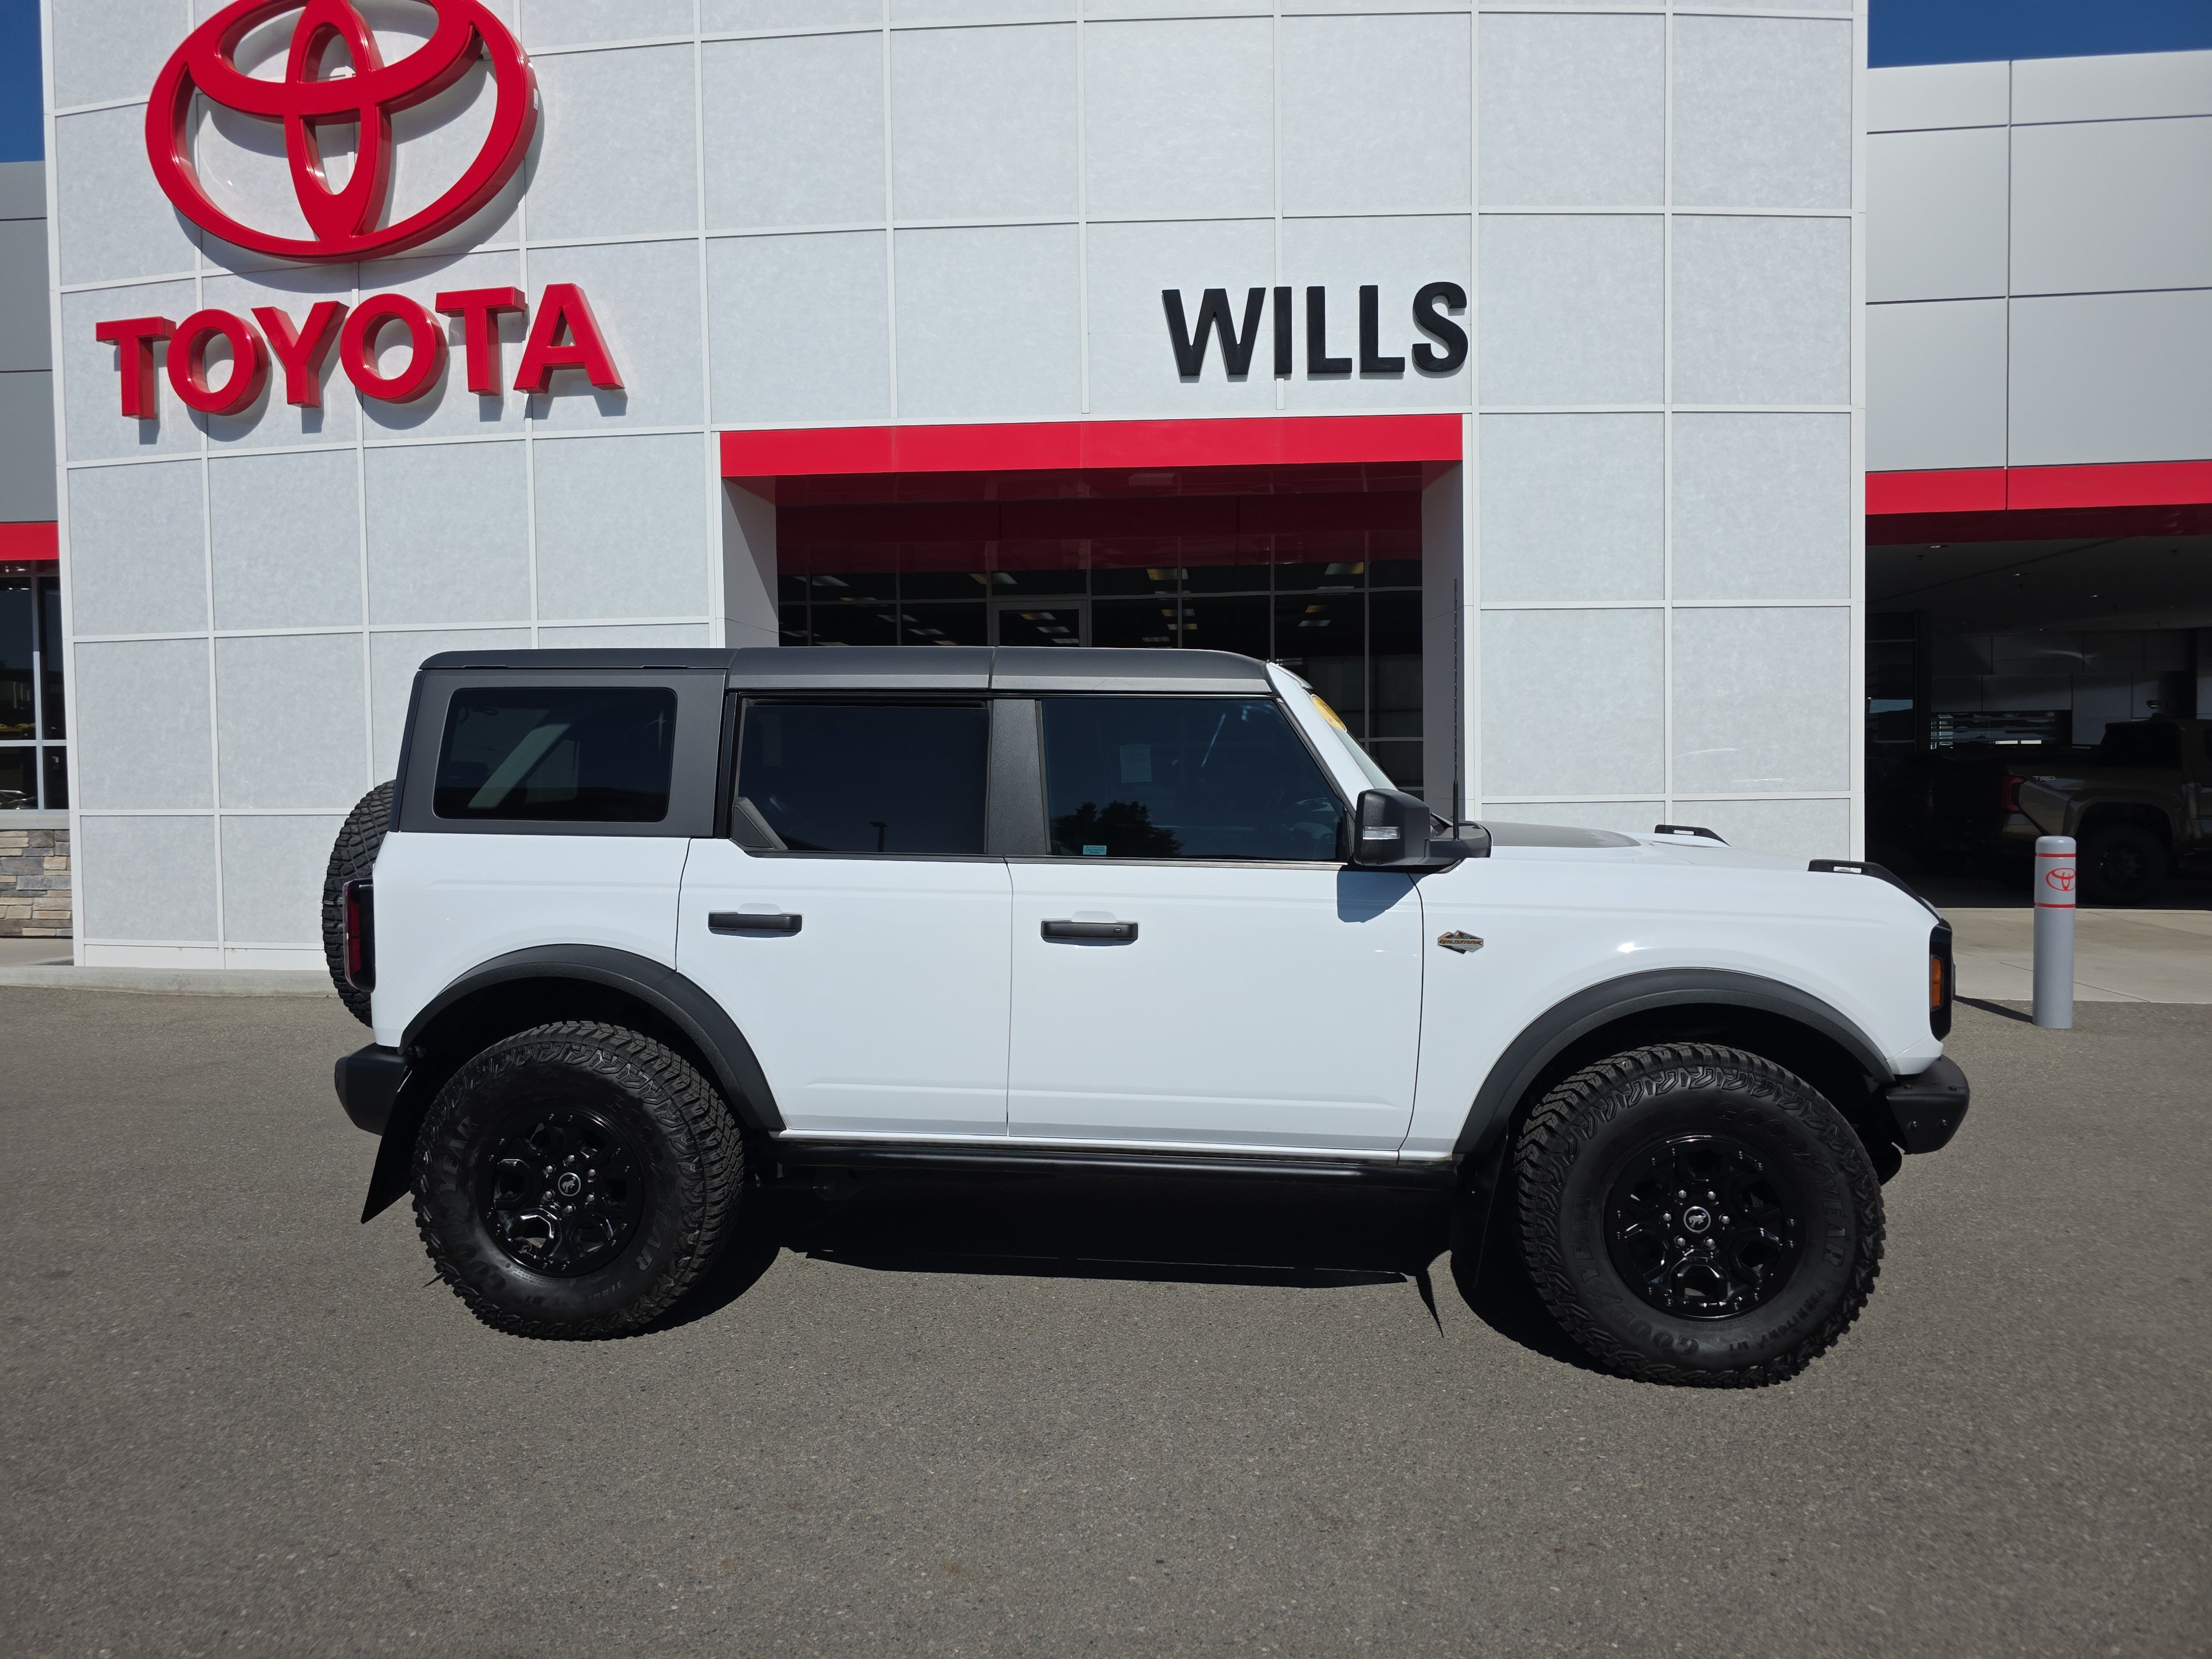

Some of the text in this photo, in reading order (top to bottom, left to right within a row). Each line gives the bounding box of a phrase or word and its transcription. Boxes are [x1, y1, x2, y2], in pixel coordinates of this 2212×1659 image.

[96, 283, 625, 420] TOYOTA
[1162, 281, 1468, 376] WILLS
[1714, 1101, 1846, 1267] GOODYEAR
[1570, 1194, 1699, 1354] GOODYEAR
